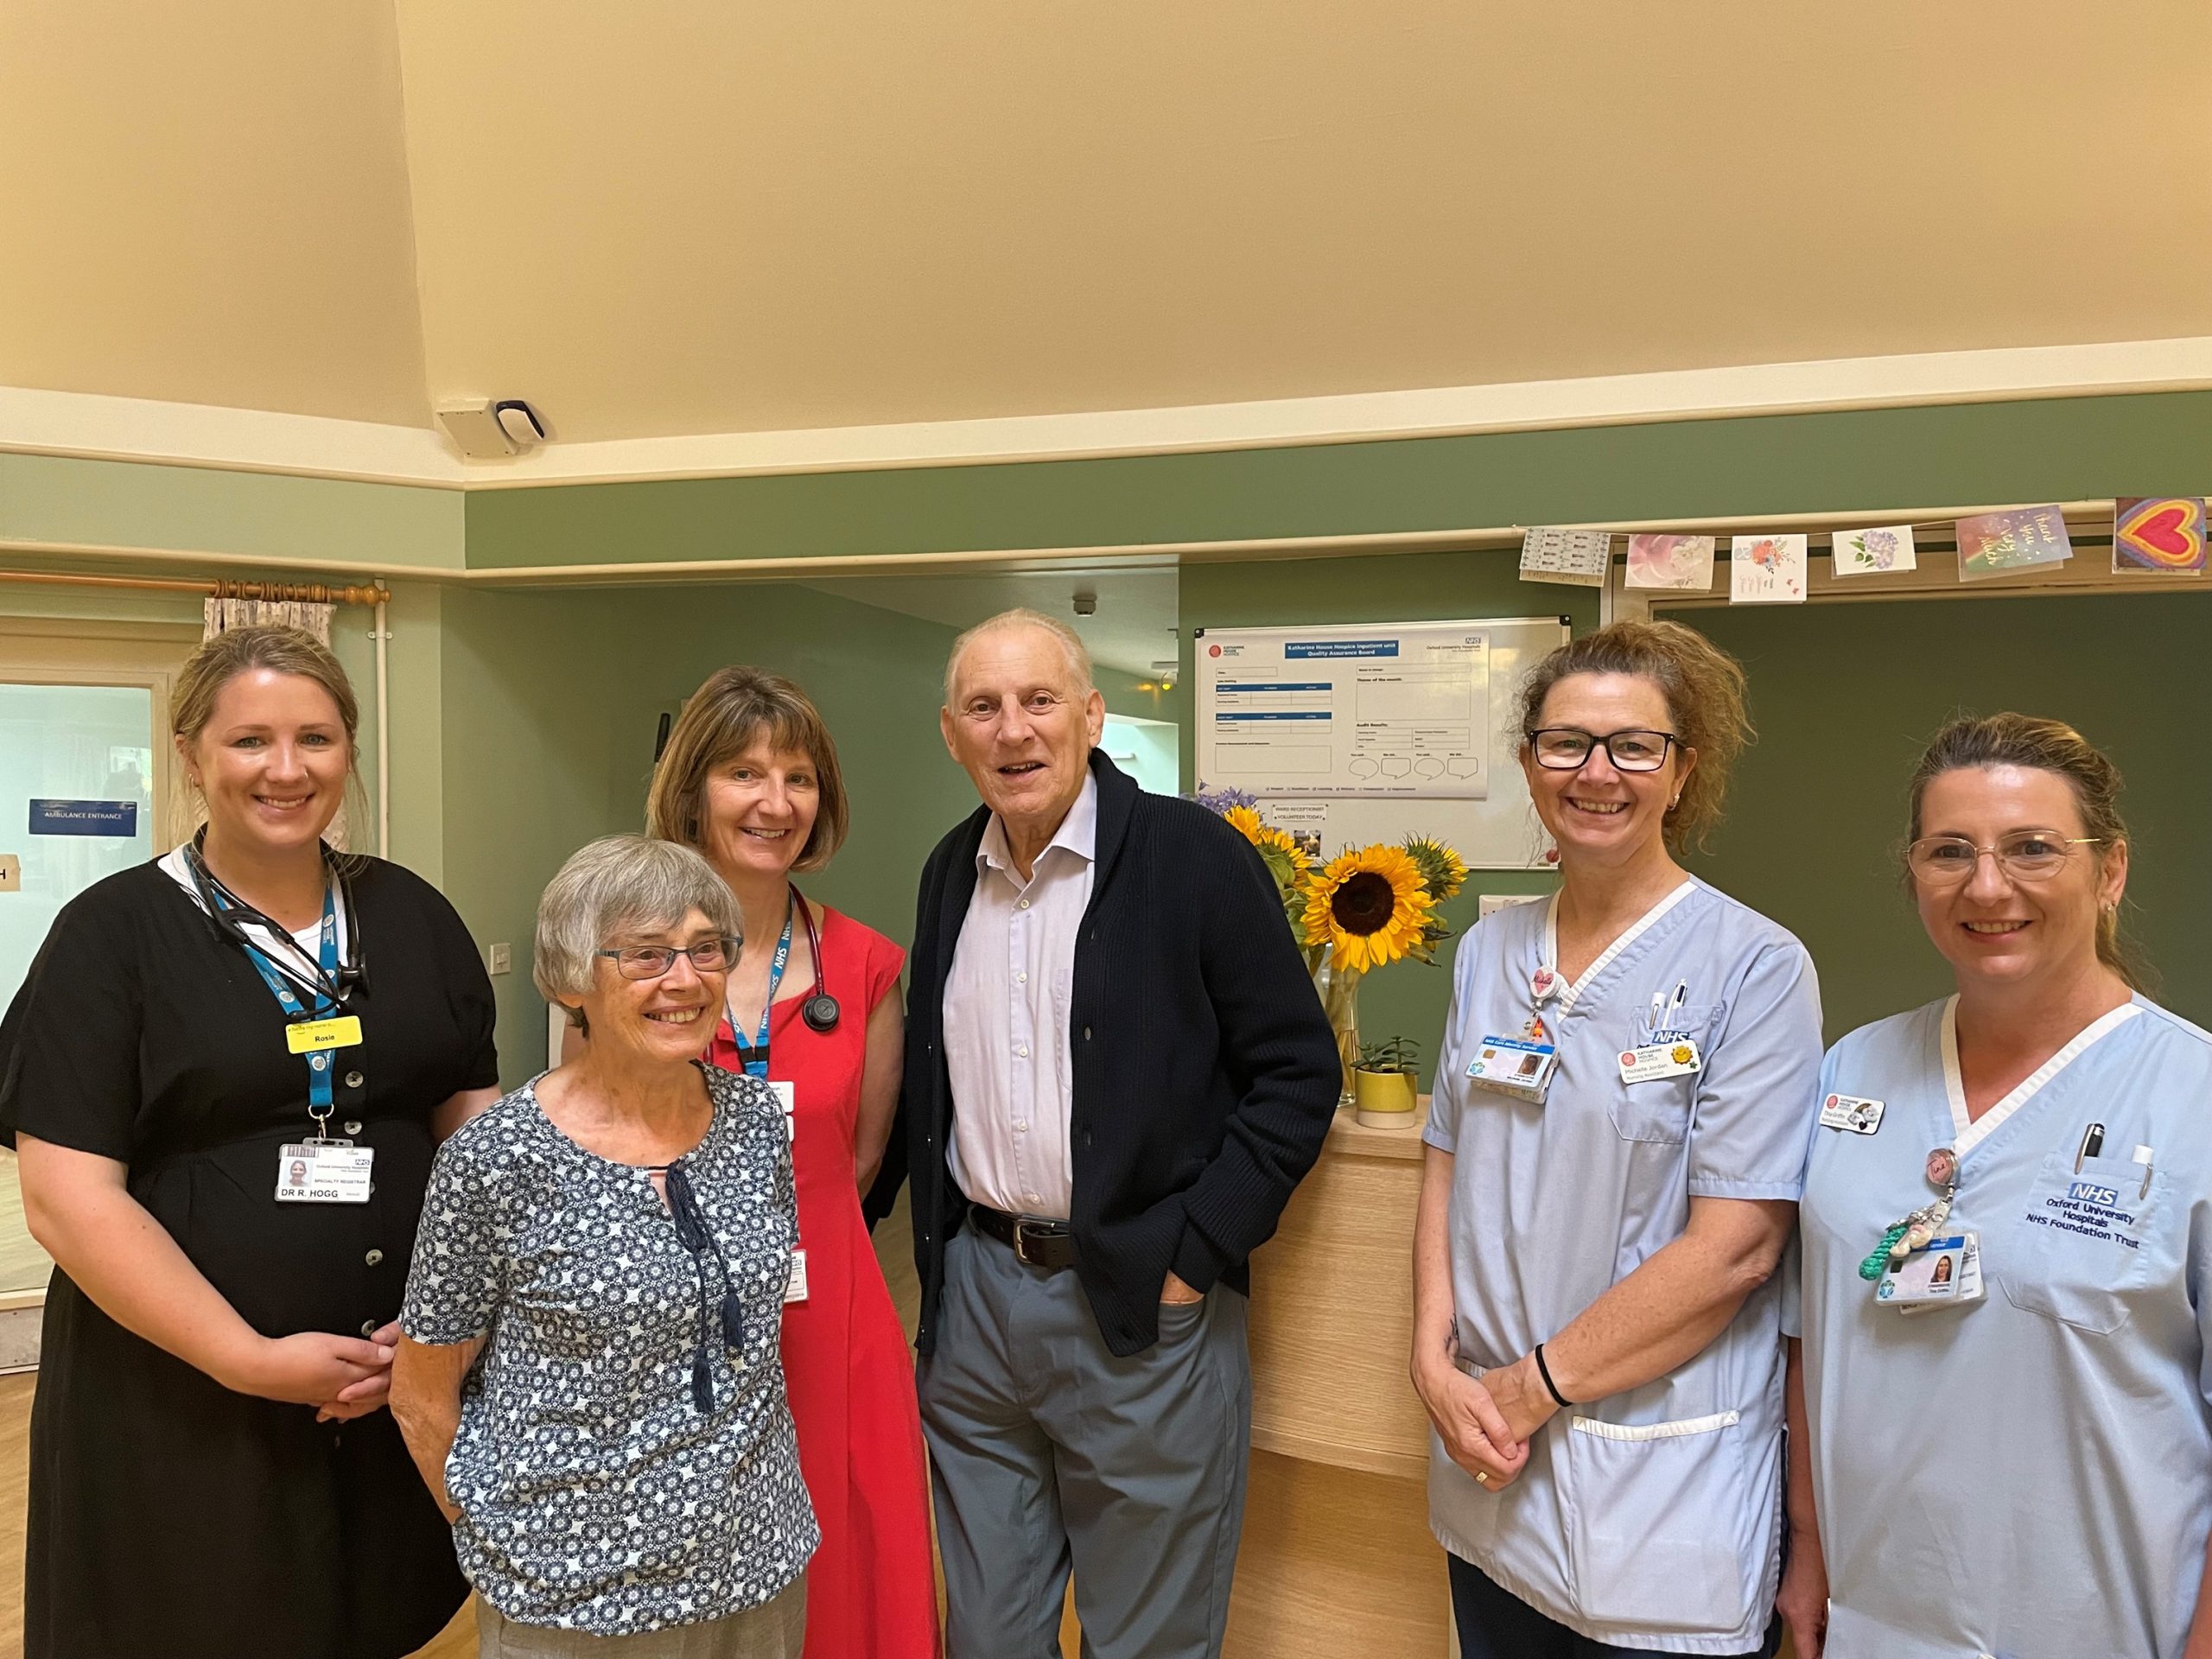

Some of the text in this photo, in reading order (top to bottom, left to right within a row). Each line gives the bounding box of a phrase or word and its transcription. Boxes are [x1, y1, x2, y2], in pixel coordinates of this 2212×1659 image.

[774, 947, 787, 969] NHS
[1654, 1031, 1688, 1043] NHS
[2072, 1183, 2116, 1205] NHS
[2046, 1198, 2135, 1225] Oxford University
[2063, 1210, 2108, 1228] Hospitals
[2025, 1213, 2139, 1249] NHS Foundation Trust
